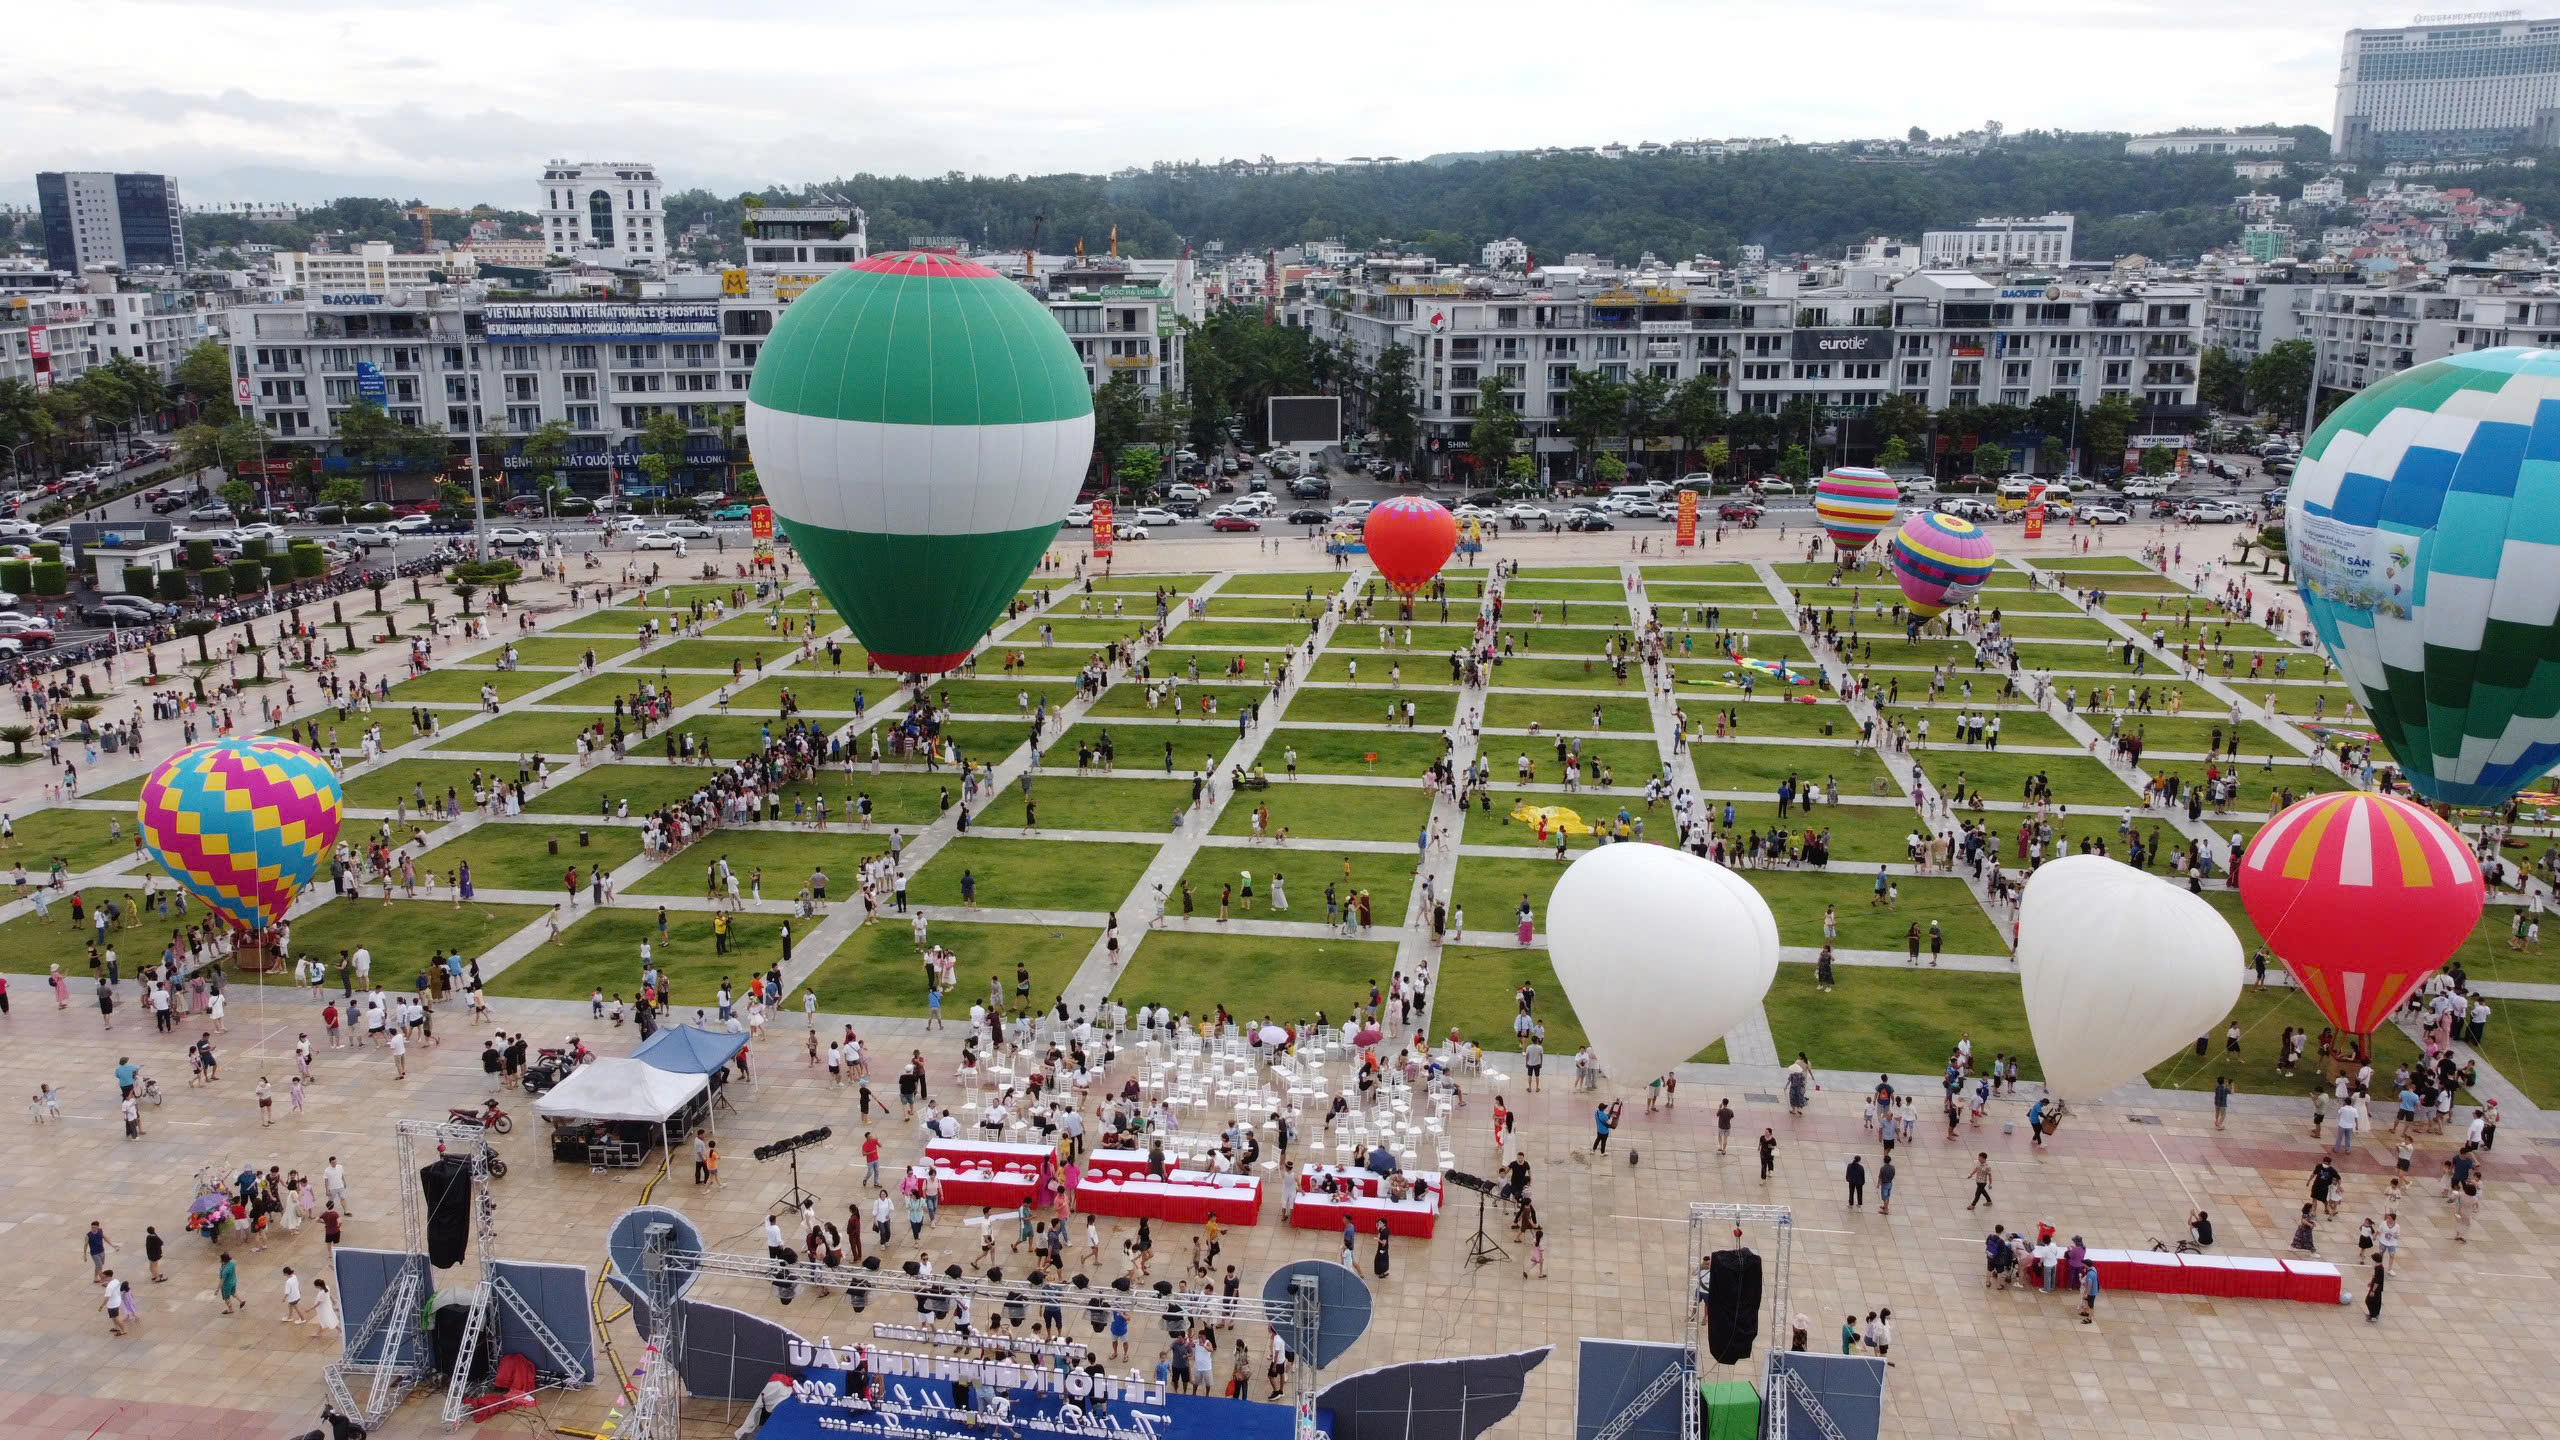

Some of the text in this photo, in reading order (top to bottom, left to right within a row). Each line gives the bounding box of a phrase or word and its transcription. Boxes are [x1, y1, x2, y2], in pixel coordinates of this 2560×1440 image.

[909, 236, 924, 245] FOOT
[323, 294, 384, 305] BAOVIET
[2001, 289, 2044, 298] BAOVIET
[486, 306, 716, 319] VIETNAM-RUSSIA INTERNATIONAL EYE HOSPITAL
[1819, 335, 1866, 350] eurotile
[504, 455, 533, 469] BỆNH
[585, 453, 615, 467] QUỐC
[617, 452, 631, 466] TẾ
[2347, 555, 2370, 568] SẢN
